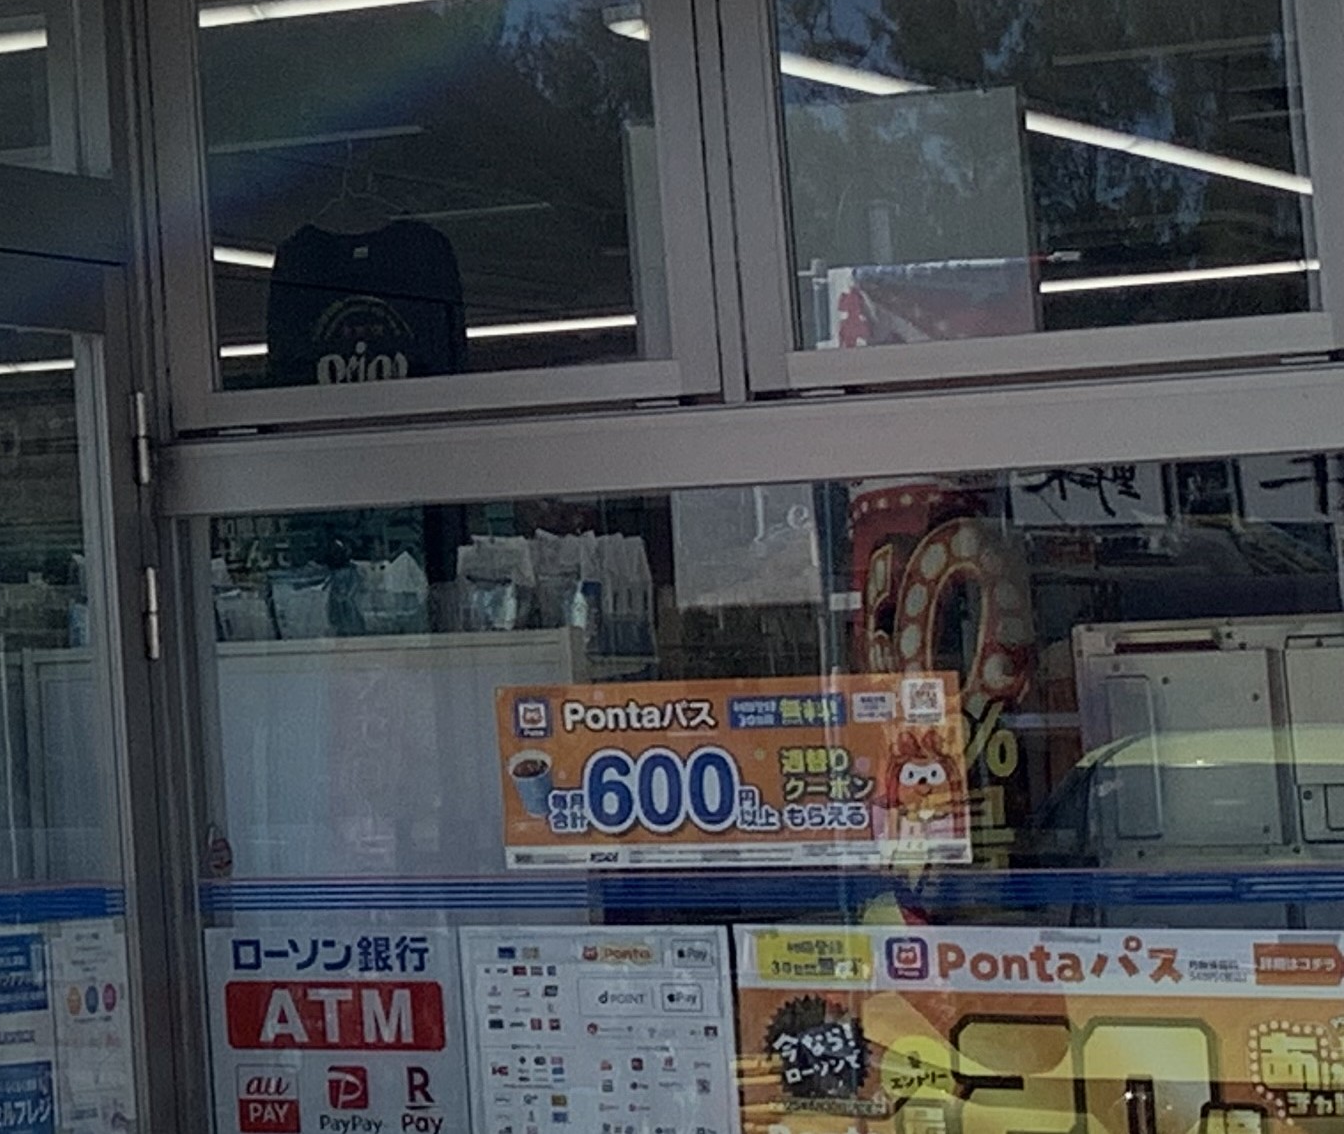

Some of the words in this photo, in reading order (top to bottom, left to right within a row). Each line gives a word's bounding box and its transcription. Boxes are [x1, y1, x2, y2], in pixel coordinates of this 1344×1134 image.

[565, 699, 717, 732] Pontaパス
[588, 752, 737, 827] 600
[785, 777, 874, 801] クーポン
[787, 806, 867, 827] もらえる
[232, 936, 430, 972] ローソン銀行
[937, 935, 1184, 984] Pontaパス
[260, 988, 414, 1044] ATM
[245, 1076, 290, 1096] au
[406, 1066, 435, 1103] R
[249, 1104, 290, 1123] PAY
[320, 1114, 384, 1134] PayPay
[401, 1114, 444, 1134] Pay
